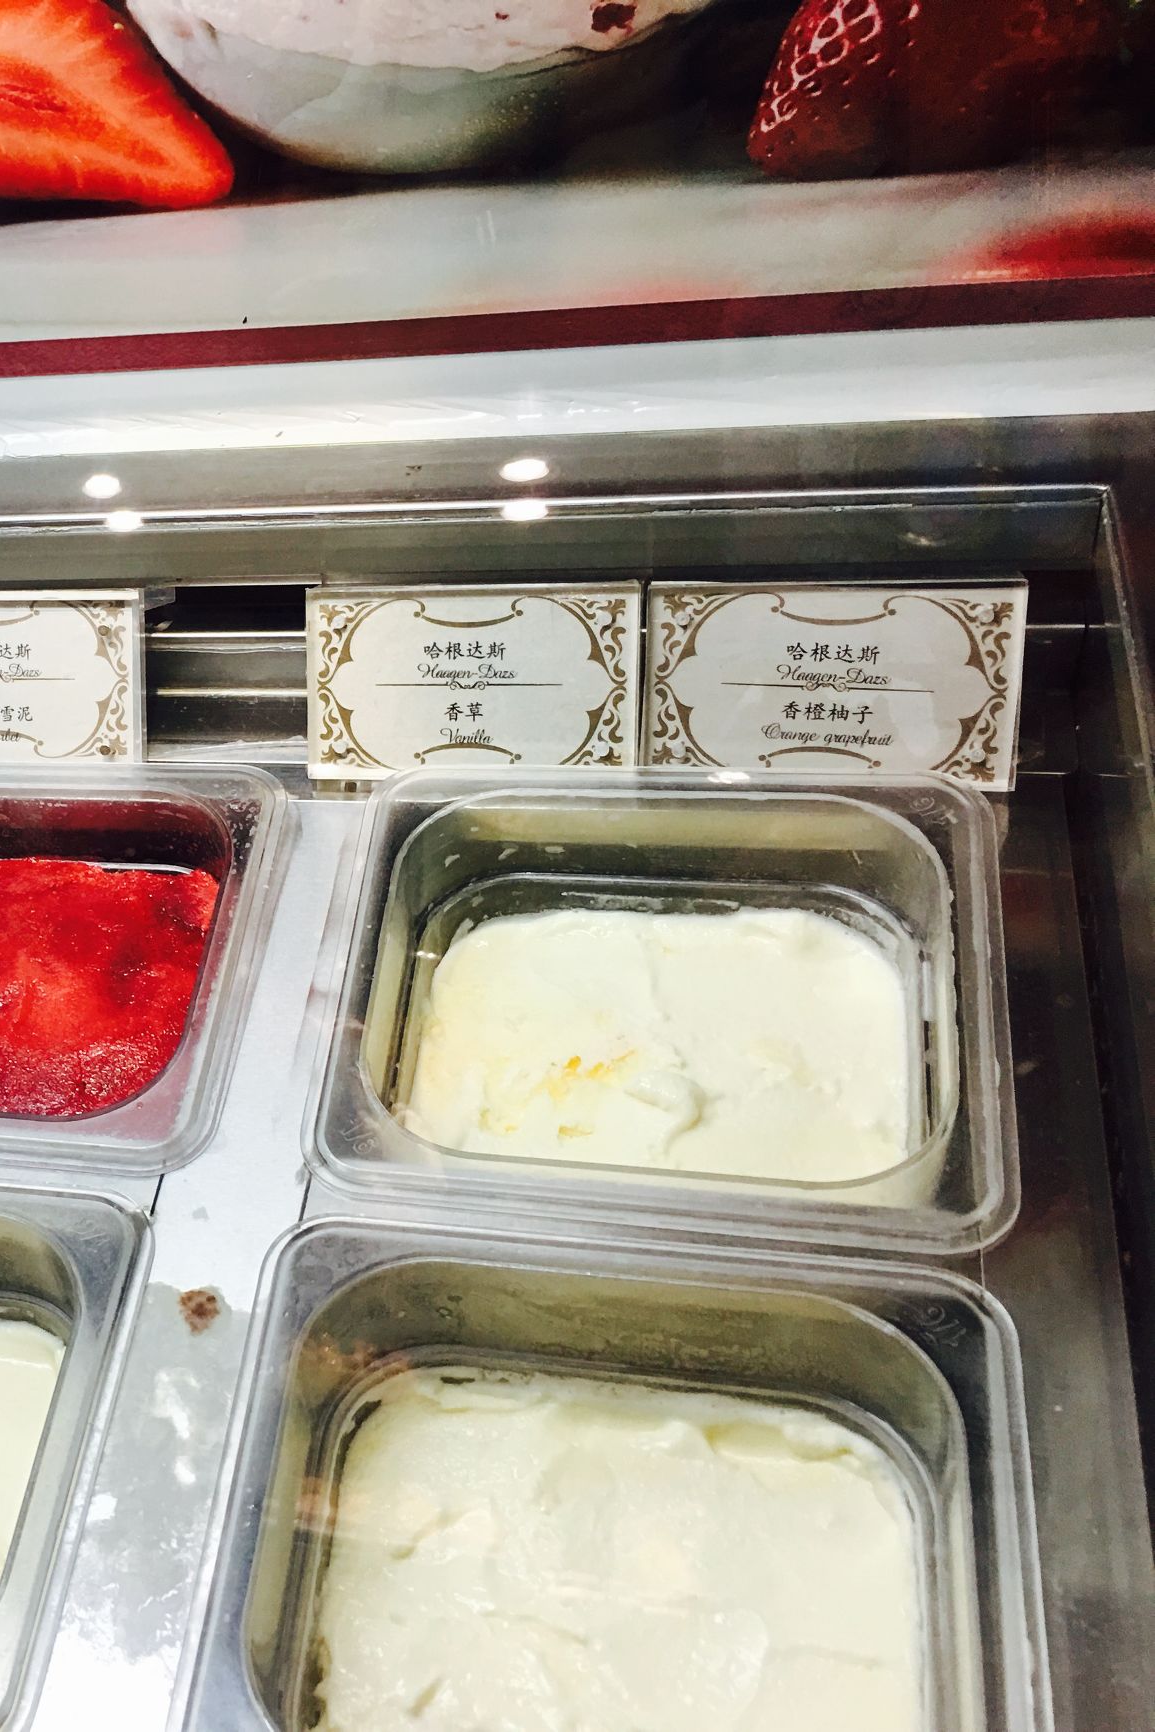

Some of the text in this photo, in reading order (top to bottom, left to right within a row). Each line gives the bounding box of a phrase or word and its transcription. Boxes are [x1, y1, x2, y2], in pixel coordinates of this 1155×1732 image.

[423, 641, 506, 660] 哈根达斯
[786, 642, 880, 665] 哈根达斯
[445, 702, 484, 722] 香草
[782, 700, 873, 725] 香橙柚子
[440, 727, 493, 744] Vanilla
[761, 722, 894, 748] Orange grapefruit
